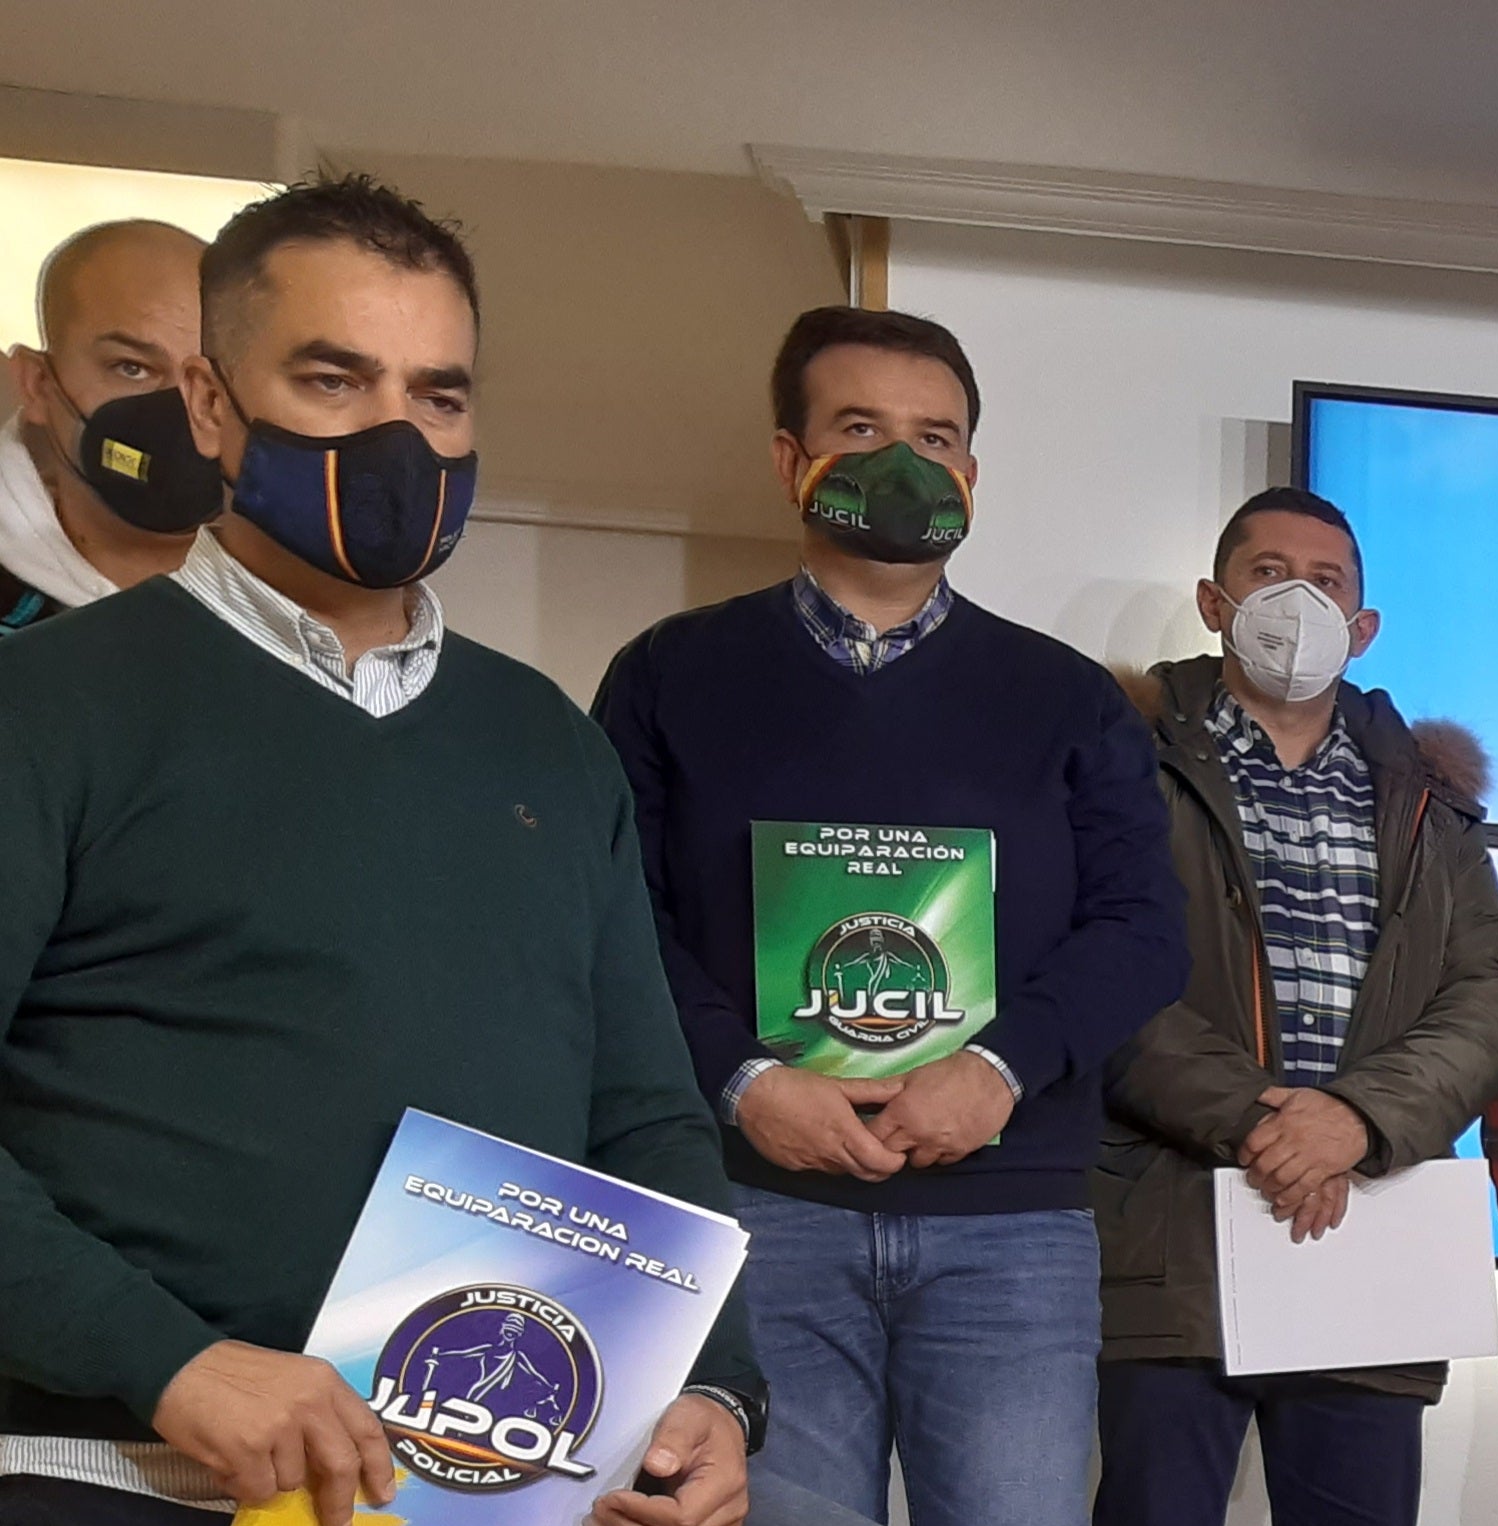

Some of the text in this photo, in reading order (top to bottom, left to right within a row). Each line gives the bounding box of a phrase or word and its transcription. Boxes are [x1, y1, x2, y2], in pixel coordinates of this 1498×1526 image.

[809, 501, 871, 530] JUCIL
[921, 528, 964, 541] JUCIL
[820, 827, 928, 843] POR UNA
[784, 842, 965, 860] EQUIPARACIÓN
[847, 862, 902, 875] REAL
[839, 916, 916, 937] JUSTICIA
[794, 989, 965, 1020] JUCIL
[828, 1016, 930, 1043] GUARDIA CIVIL
[498, 1182, 629, 1242] POR UNA
[403, 1175, 701, 1293] EQUIPARACION REAL
[460, 1290, 577, 1344] JUSTICIA
[367, 1376, 597, 1479] JUPOL
[396, 1438, 522, 1484] POLICIAL
